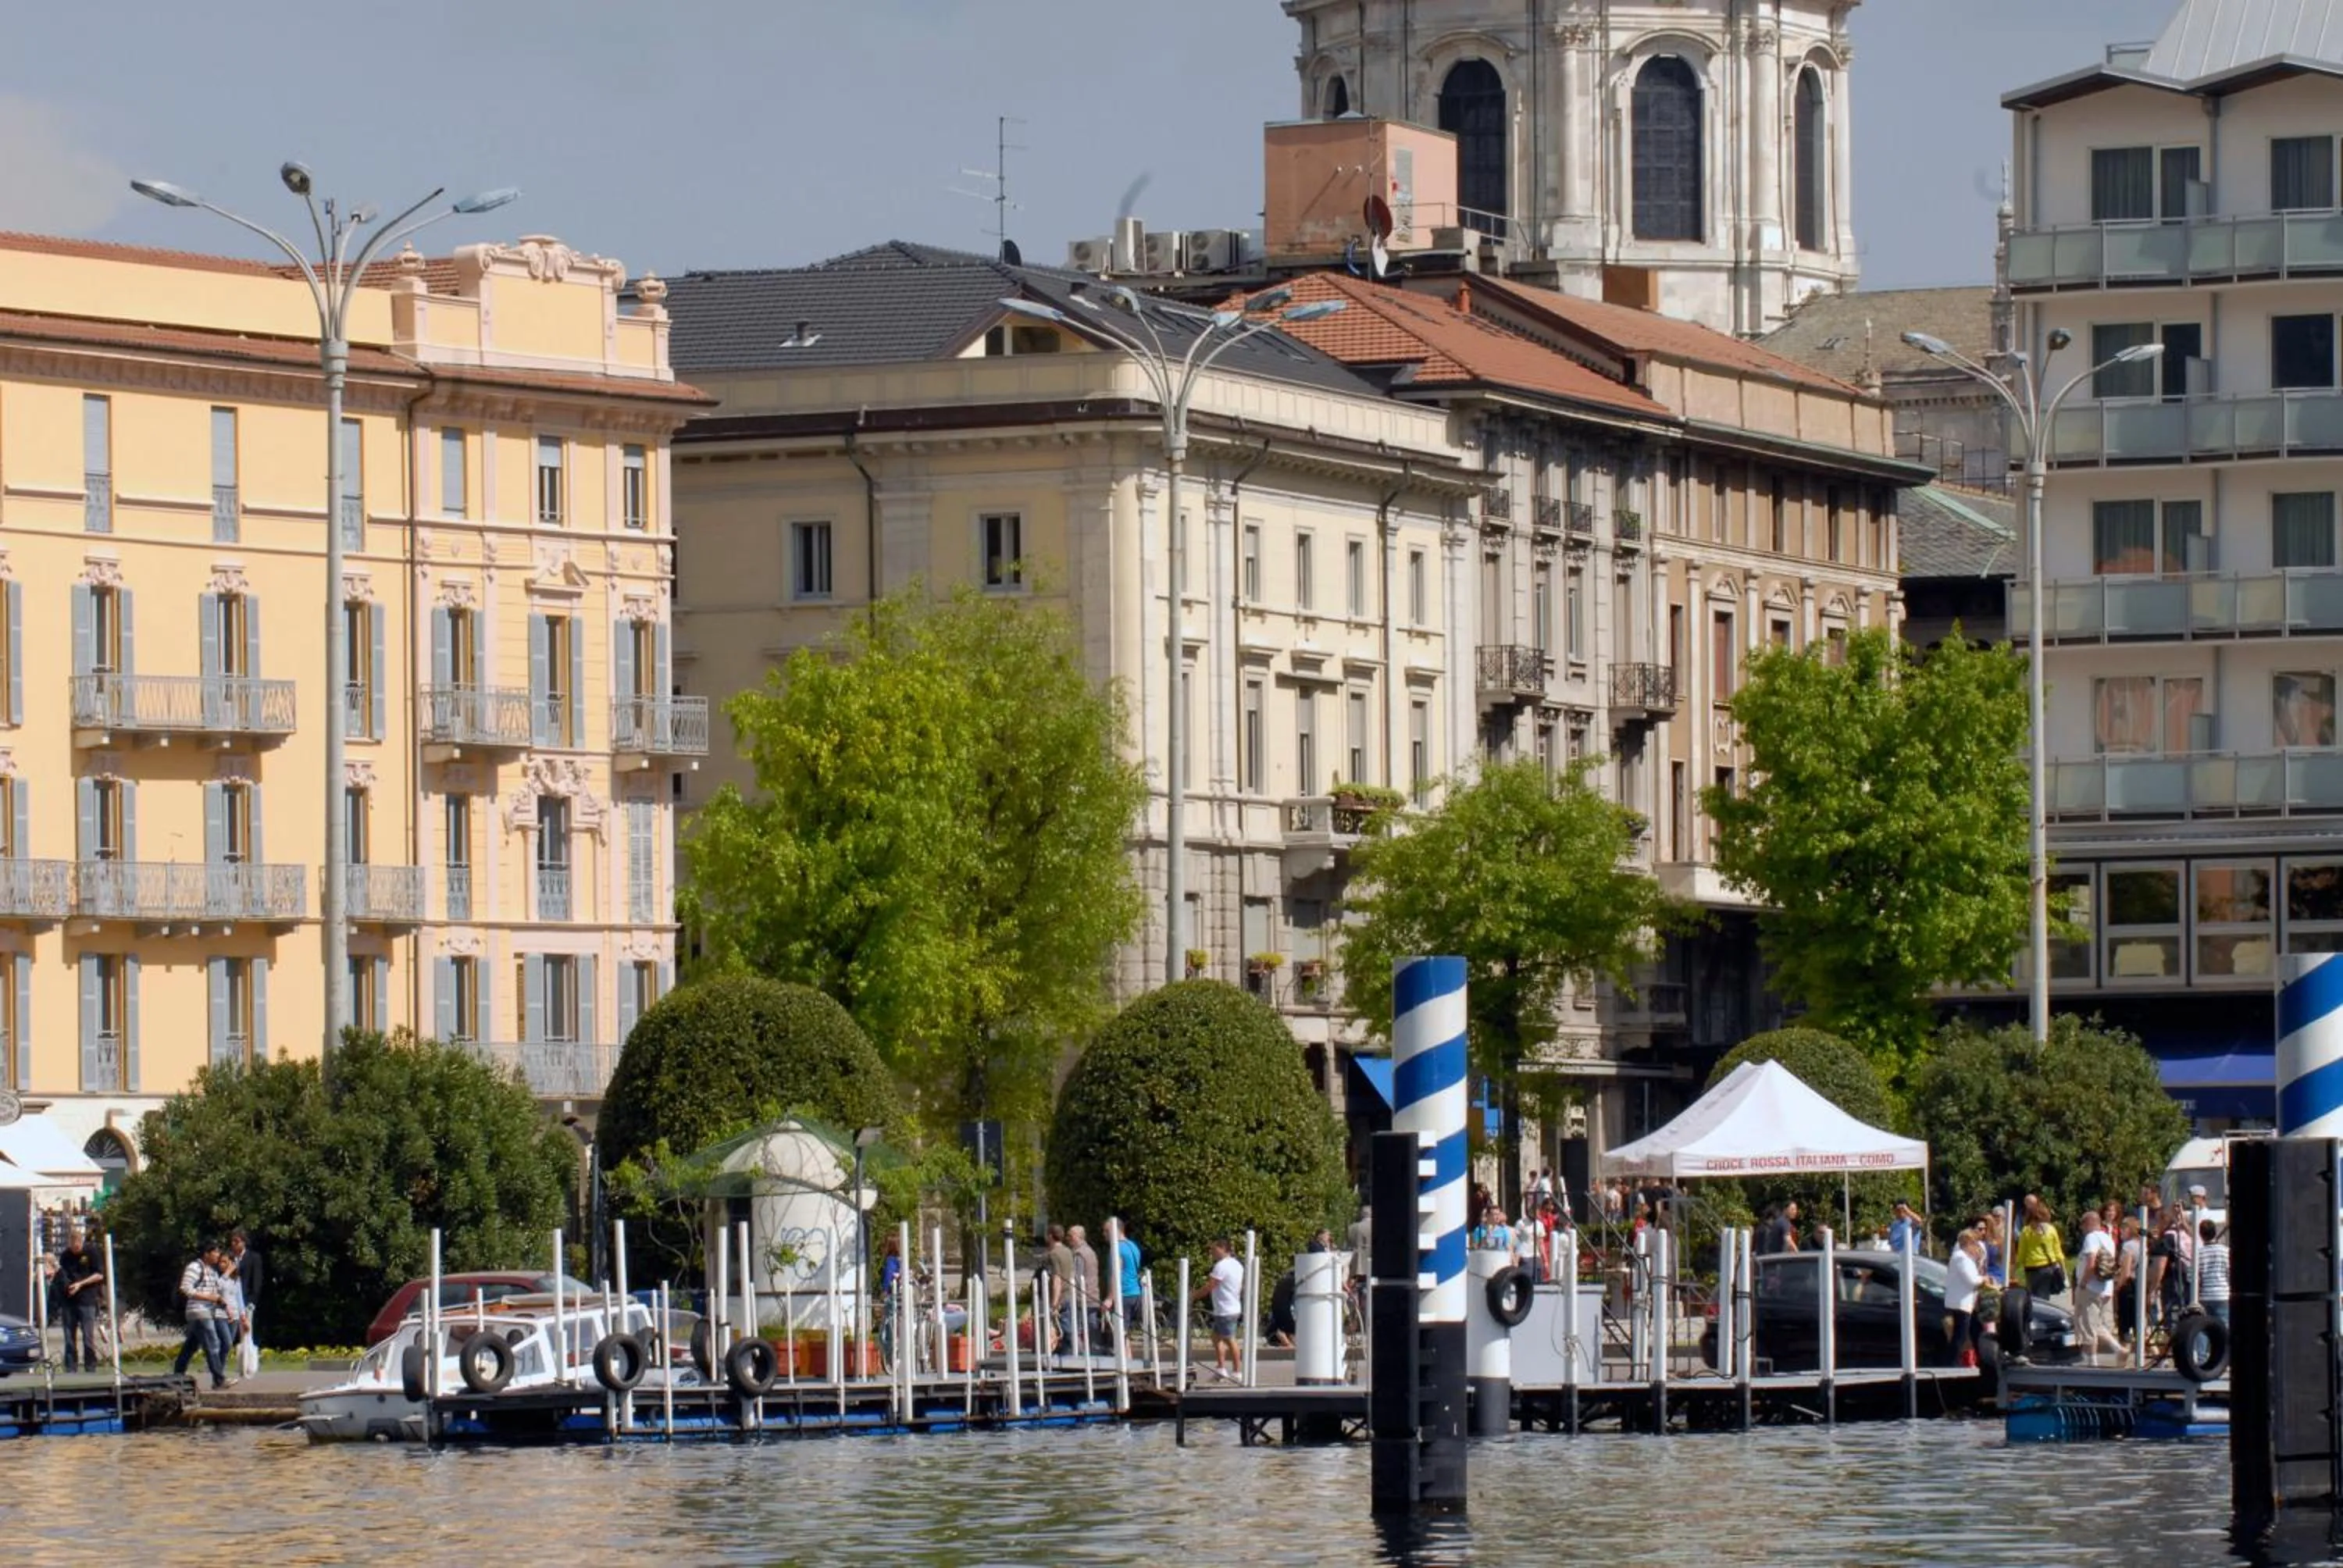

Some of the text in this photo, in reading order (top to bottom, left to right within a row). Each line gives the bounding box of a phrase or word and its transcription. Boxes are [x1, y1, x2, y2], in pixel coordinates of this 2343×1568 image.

[1706, 1158, 1744, 1171] CROCE
[1750, 1156, 1790, 1169] ROSSA
[1796, 1153, 1847, 1167] ITALIANA
[1860, 1153, 1894, 1166] COMO
